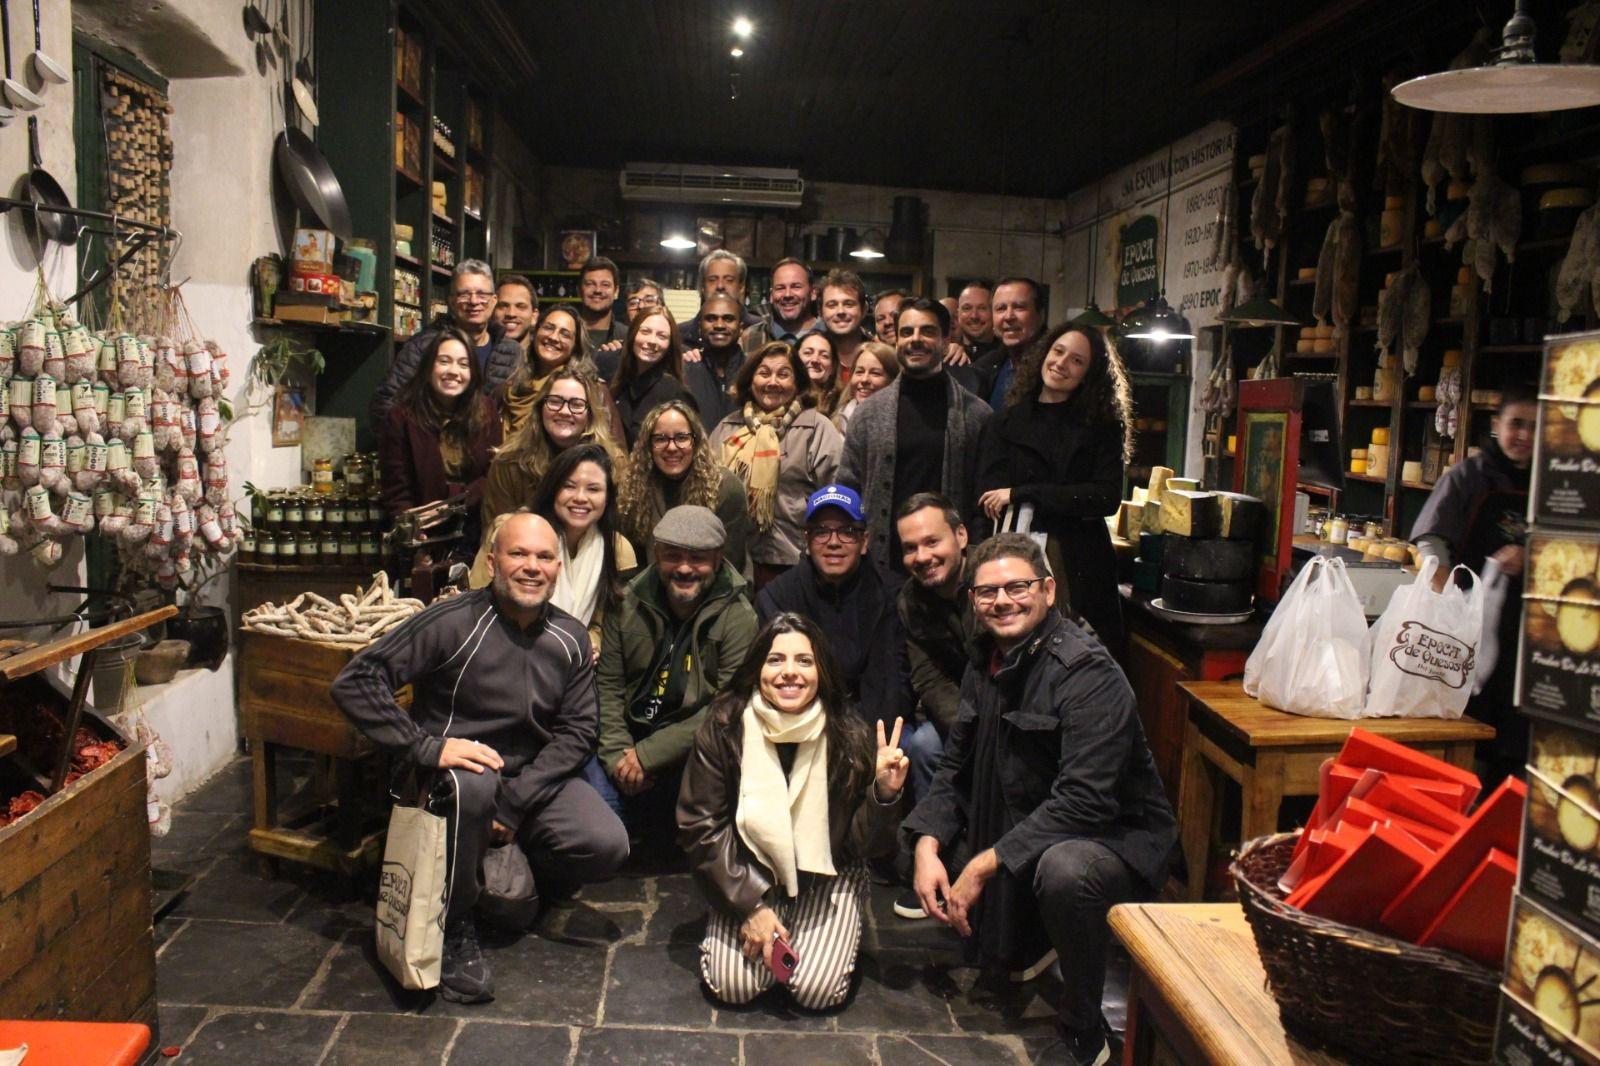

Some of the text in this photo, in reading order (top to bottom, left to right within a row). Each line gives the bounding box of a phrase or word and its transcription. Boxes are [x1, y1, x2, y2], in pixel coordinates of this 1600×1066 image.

[1173, 154, 1190, 174] CON
[1191, 135, 1232, 165] HISTORIA
[1185, 221, 1216, 246] 1920-197
[1124, 238, 1154, 266] EPOCA
[1130, 265, 1156, 287] Quesos
[1182, 288, 1221, 310] 1990 EPOC
[1404, 645, 1420, 658] de
[1422, 650, 1461, 672] Quesos
[1417, 634, 1461, 659] EPOCA
